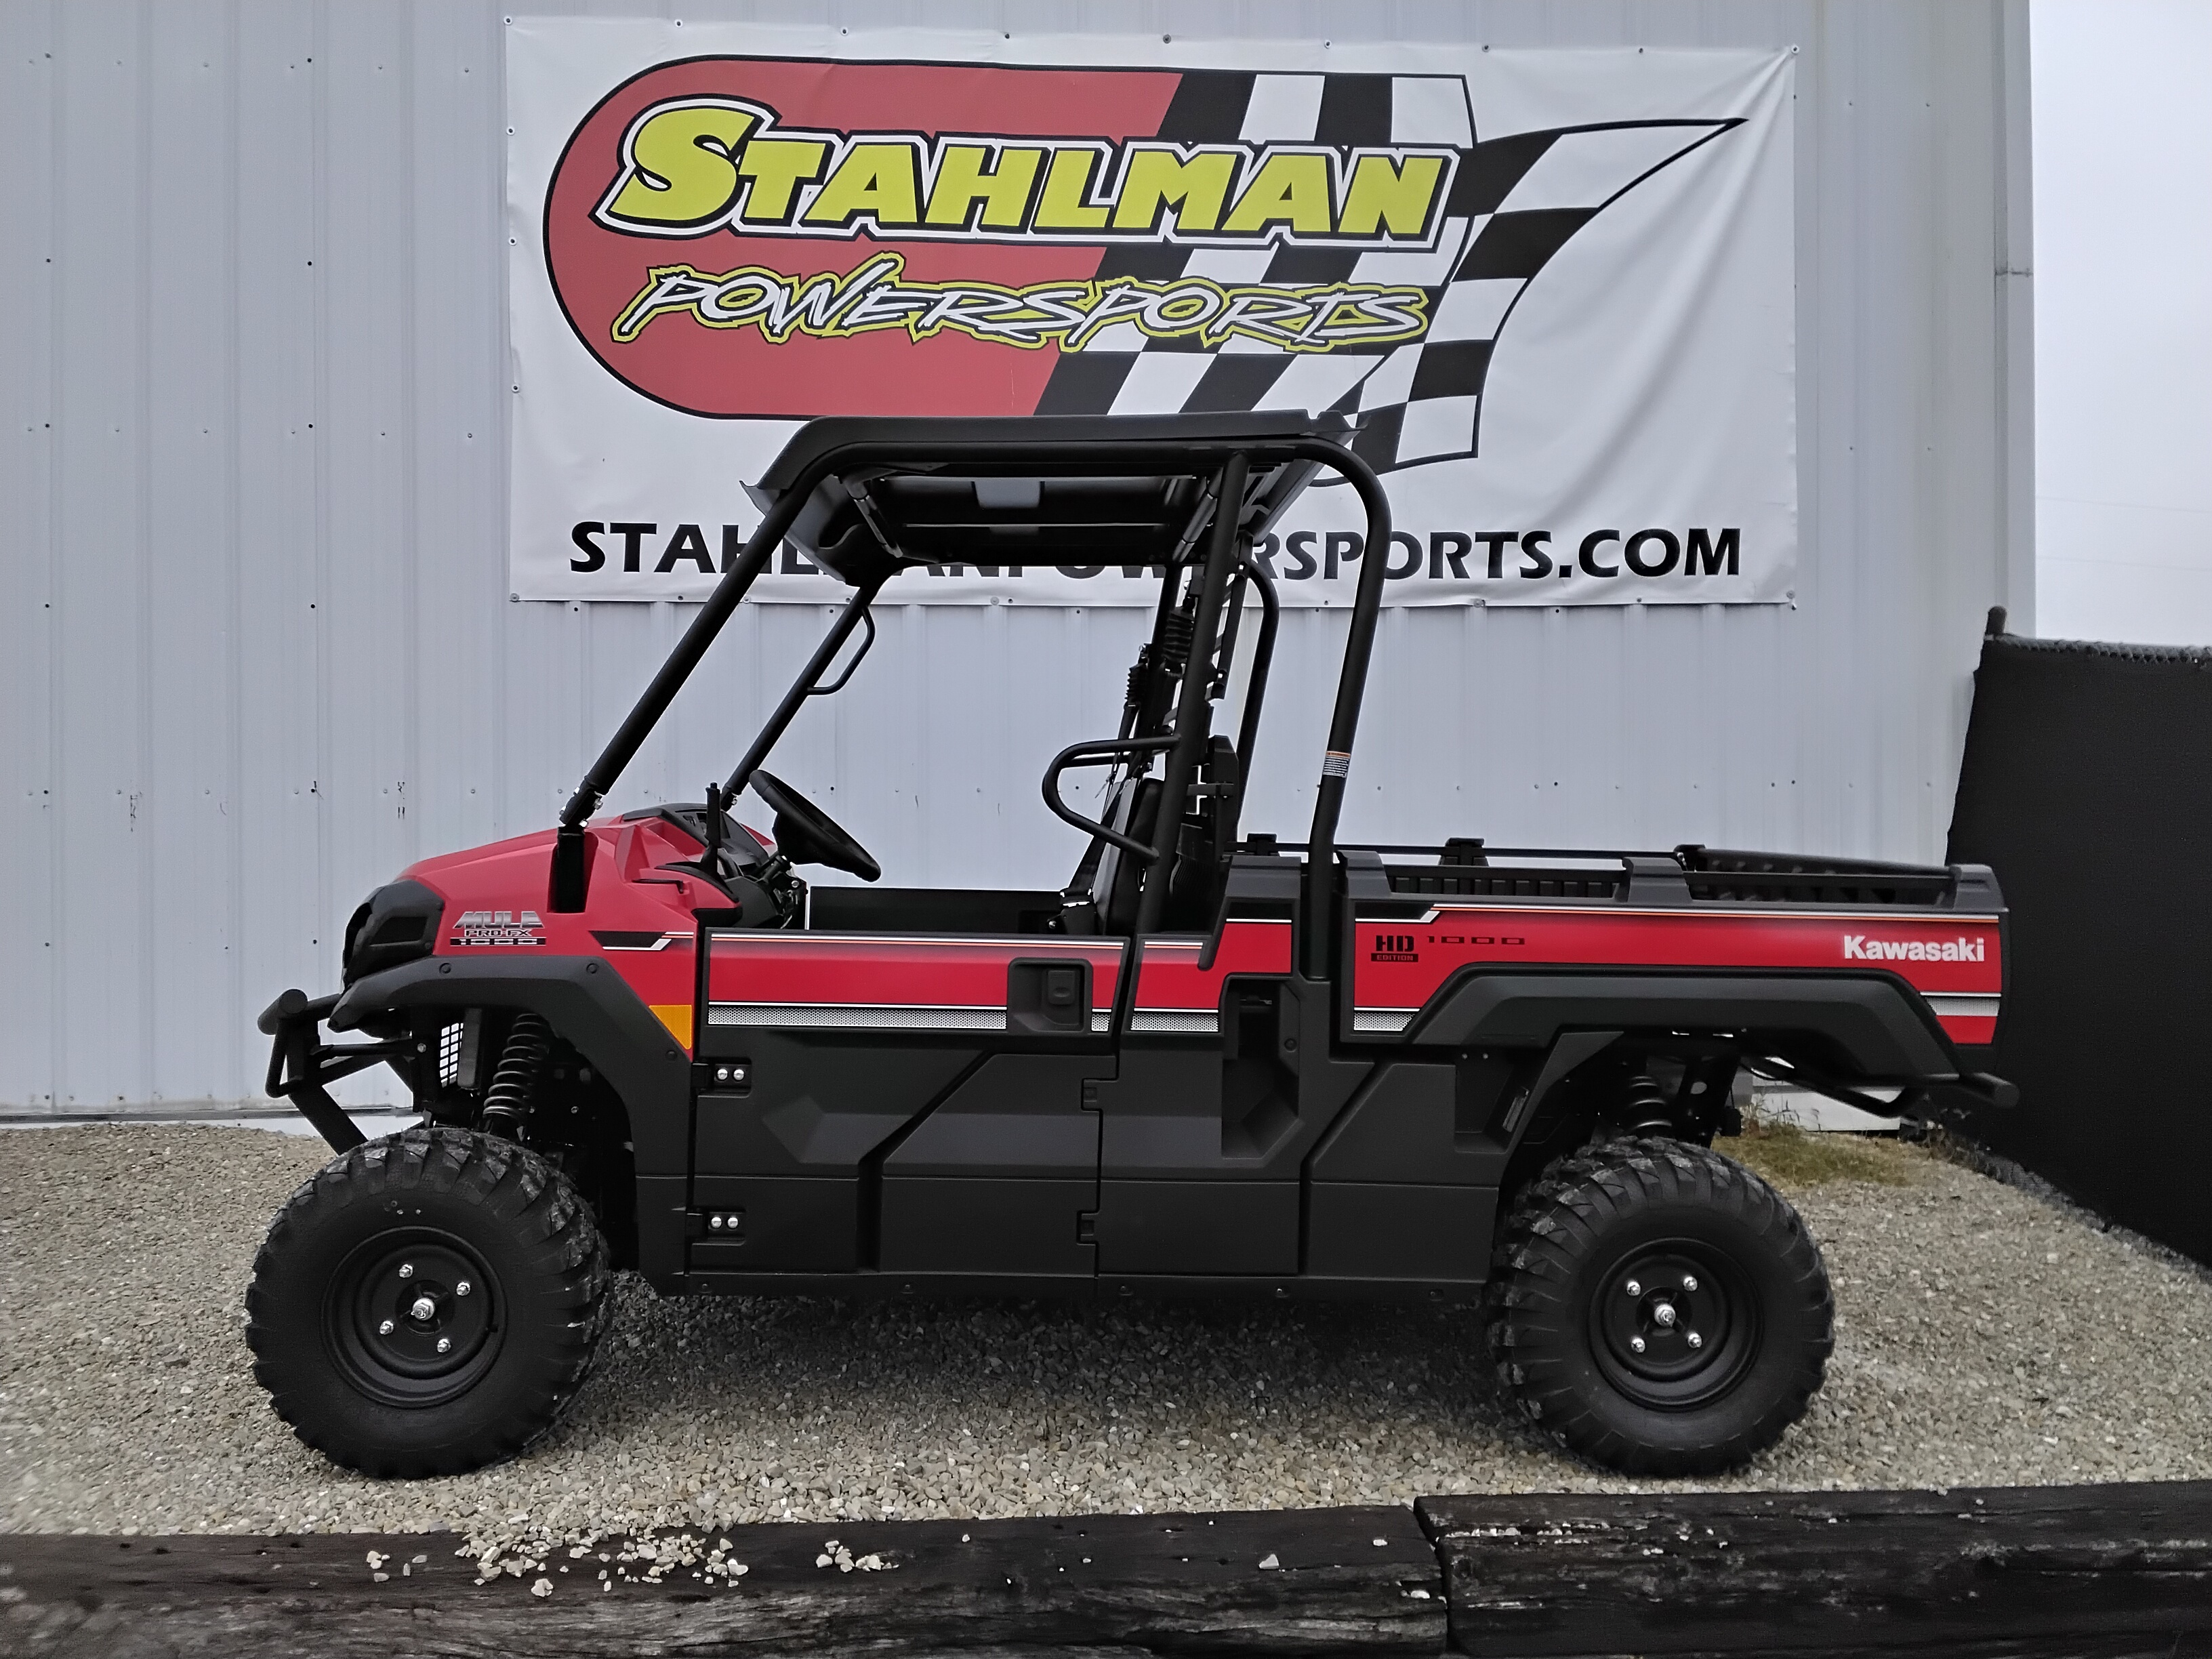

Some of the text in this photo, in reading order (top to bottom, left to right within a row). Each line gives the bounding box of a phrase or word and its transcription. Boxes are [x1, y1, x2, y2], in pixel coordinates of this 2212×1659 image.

[596, 99, 1457, 247] STAHLMAN
[613, 253, 1427, 350] POWERSPORTS
[453, 911, 544, 928] MULE
[1376, 935, 1414, 952] HD
[1427, 935, 1525, 945] 1000
[1843, 935, 1985, 962] Kawasaki
